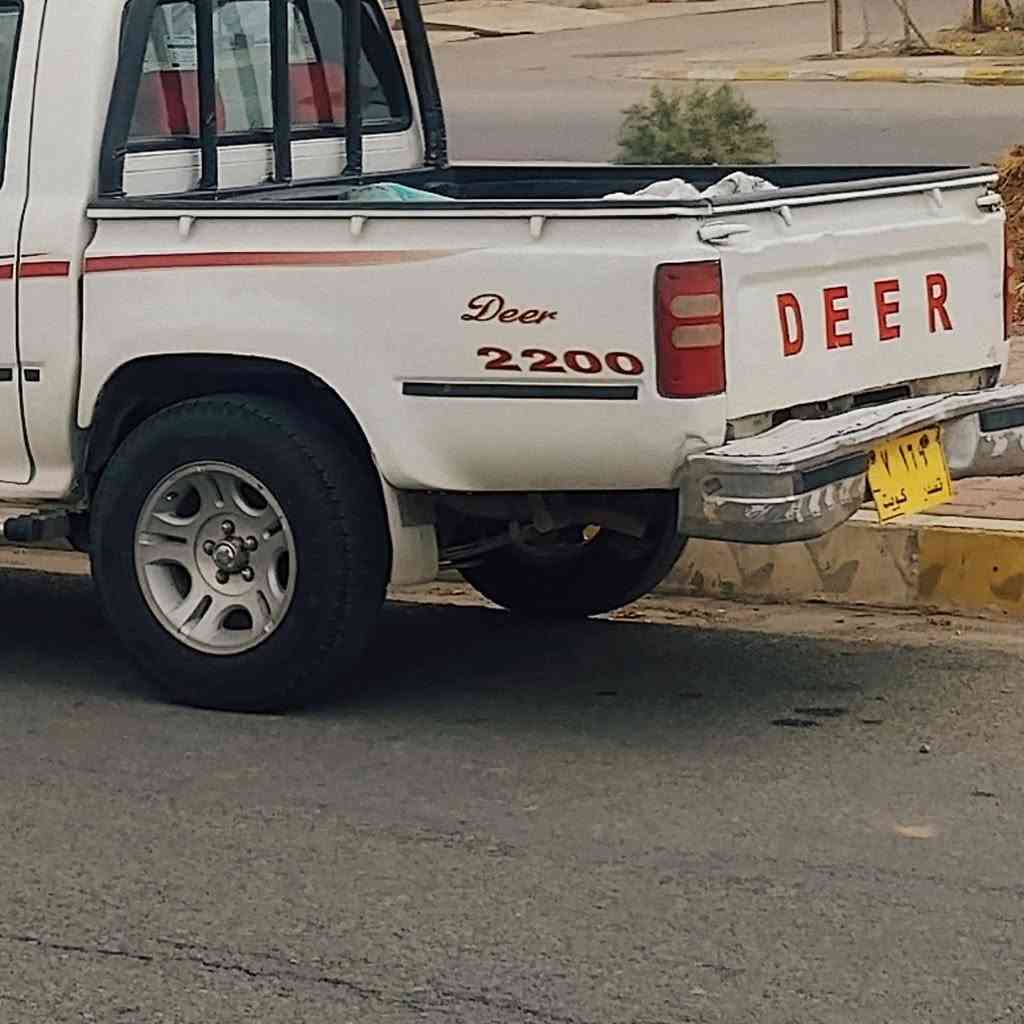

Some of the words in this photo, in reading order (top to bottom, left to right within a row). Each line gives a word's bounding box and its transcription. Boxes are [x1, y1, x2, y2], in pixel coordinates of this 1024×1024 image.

[460, 293, 559, 324] Deer
[776, 273, 953, 357] DEER
[476, 346, 645, 376] 2200
